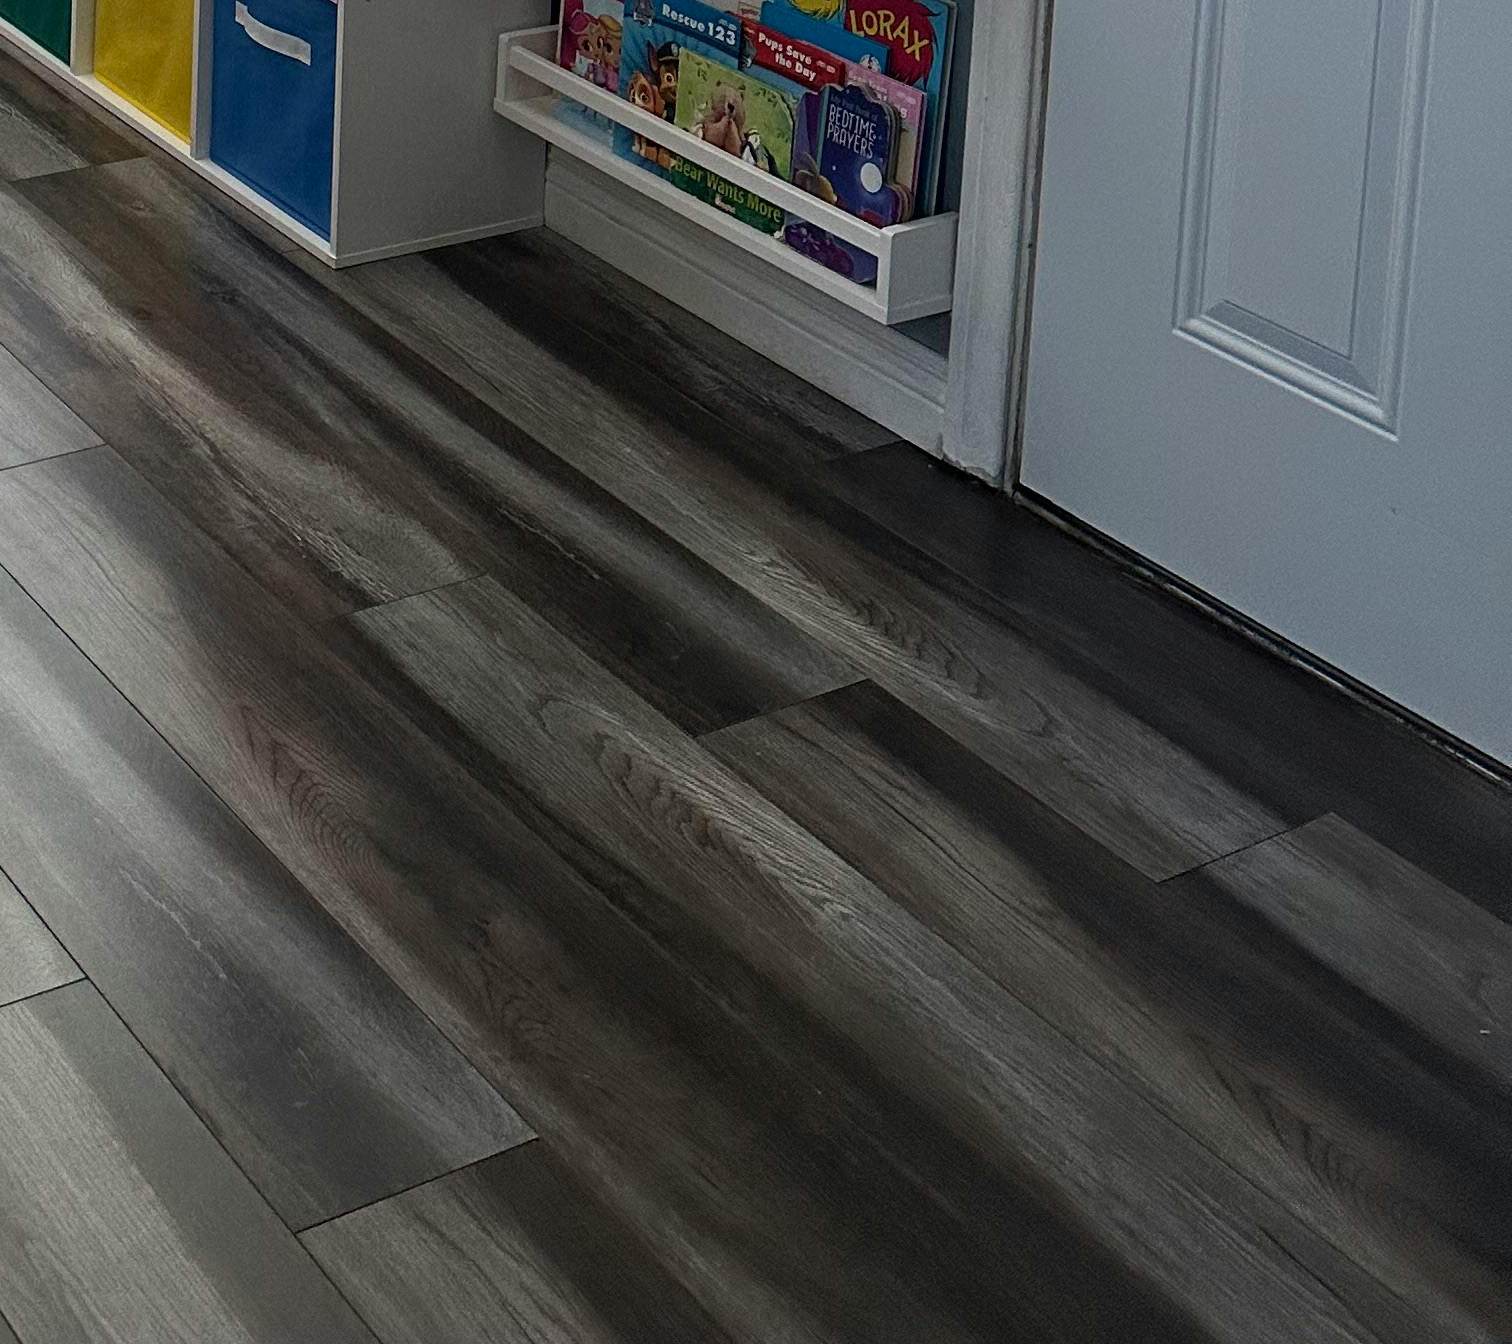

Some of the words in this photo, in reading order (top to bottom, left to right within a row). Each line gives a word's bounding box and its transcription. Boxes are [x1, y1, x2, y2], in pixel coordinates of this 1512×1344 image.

[662, 3, 706, 32] Rescue
[707, 21, 736, 46] 123
[849, 9, 930, 63] LORAX
[758, 31, 784, 52] Pups
[786, 44, 813, 65] Save
[774, 52, 792, 69] the
[795, 62, 817, 82] Day
[826, 122, 874, 160] PRAYERS
[829, 103, 877, 141] BEDTIME
[675, 155, 704, 183] Bear
[706, 172, 745, 204] Wants
[746, 193, 783, 223] More
